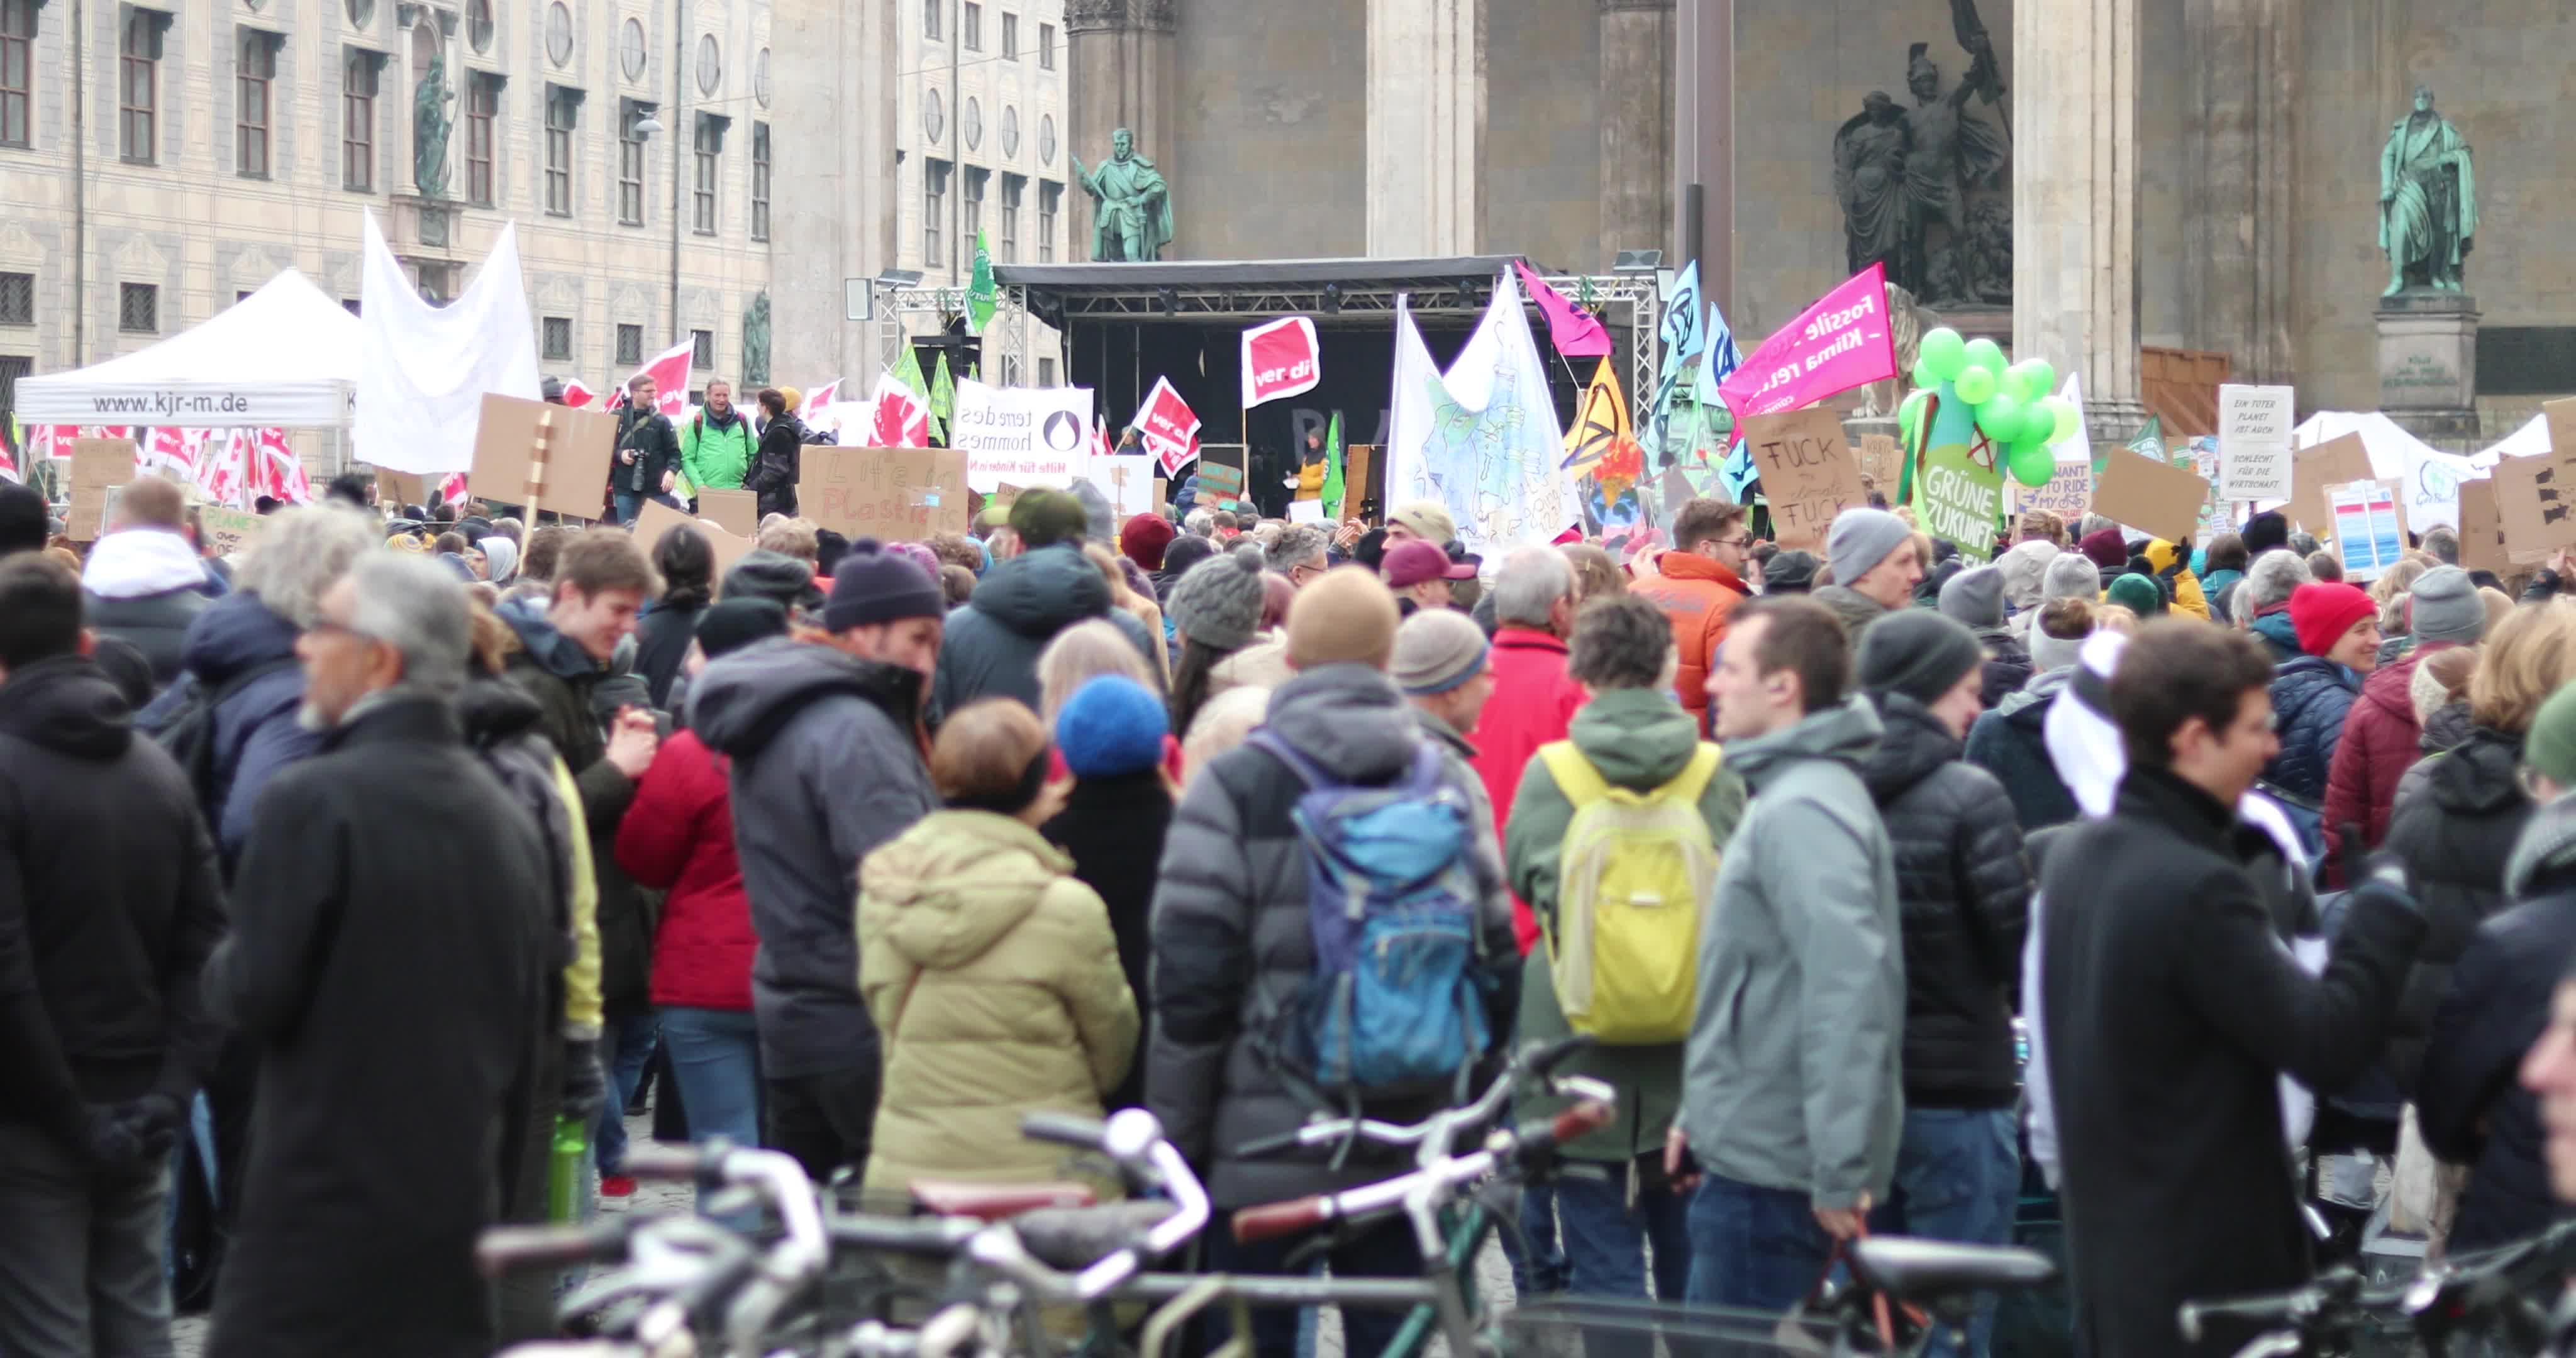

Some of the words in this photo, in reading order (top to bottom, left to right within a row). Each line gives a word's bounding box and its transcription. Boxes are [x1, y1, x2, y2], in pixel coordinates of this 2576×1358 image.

[1255, 360, 1311, 387] ver.di
[92, 392, 248, 417] www.kjr-m.de
[347, 391, 357, 409] K
[2234, 399, 2250, 408] EIN
[2251, 399, 2276, 409] TOTER
[2237, 412, 2269, 421] PLANET
[2235, 426, 2250, 434] IST
[2251, 426, 2275, 434] AUCH
[1760, 437, 1840, 470] FUCK
[2233, 454, 2275, 463] SCHLECHT
[2237, 466, 2253, 475] FÜR
[2255, 467, 2271, 476] DIE
[2045, 480, 2061, 494] TO
[2063, 479, 2089, 494] RIDE
[2228, 480, 2280, 489] WIRTSCHAFT
[1926, 465, 1996, 519] GRÜNE
[2039, 497, 2058, 509] MY
[1926, 497, 1995, 553] ZUKUNFT
[216, 531, 242, 543] over
